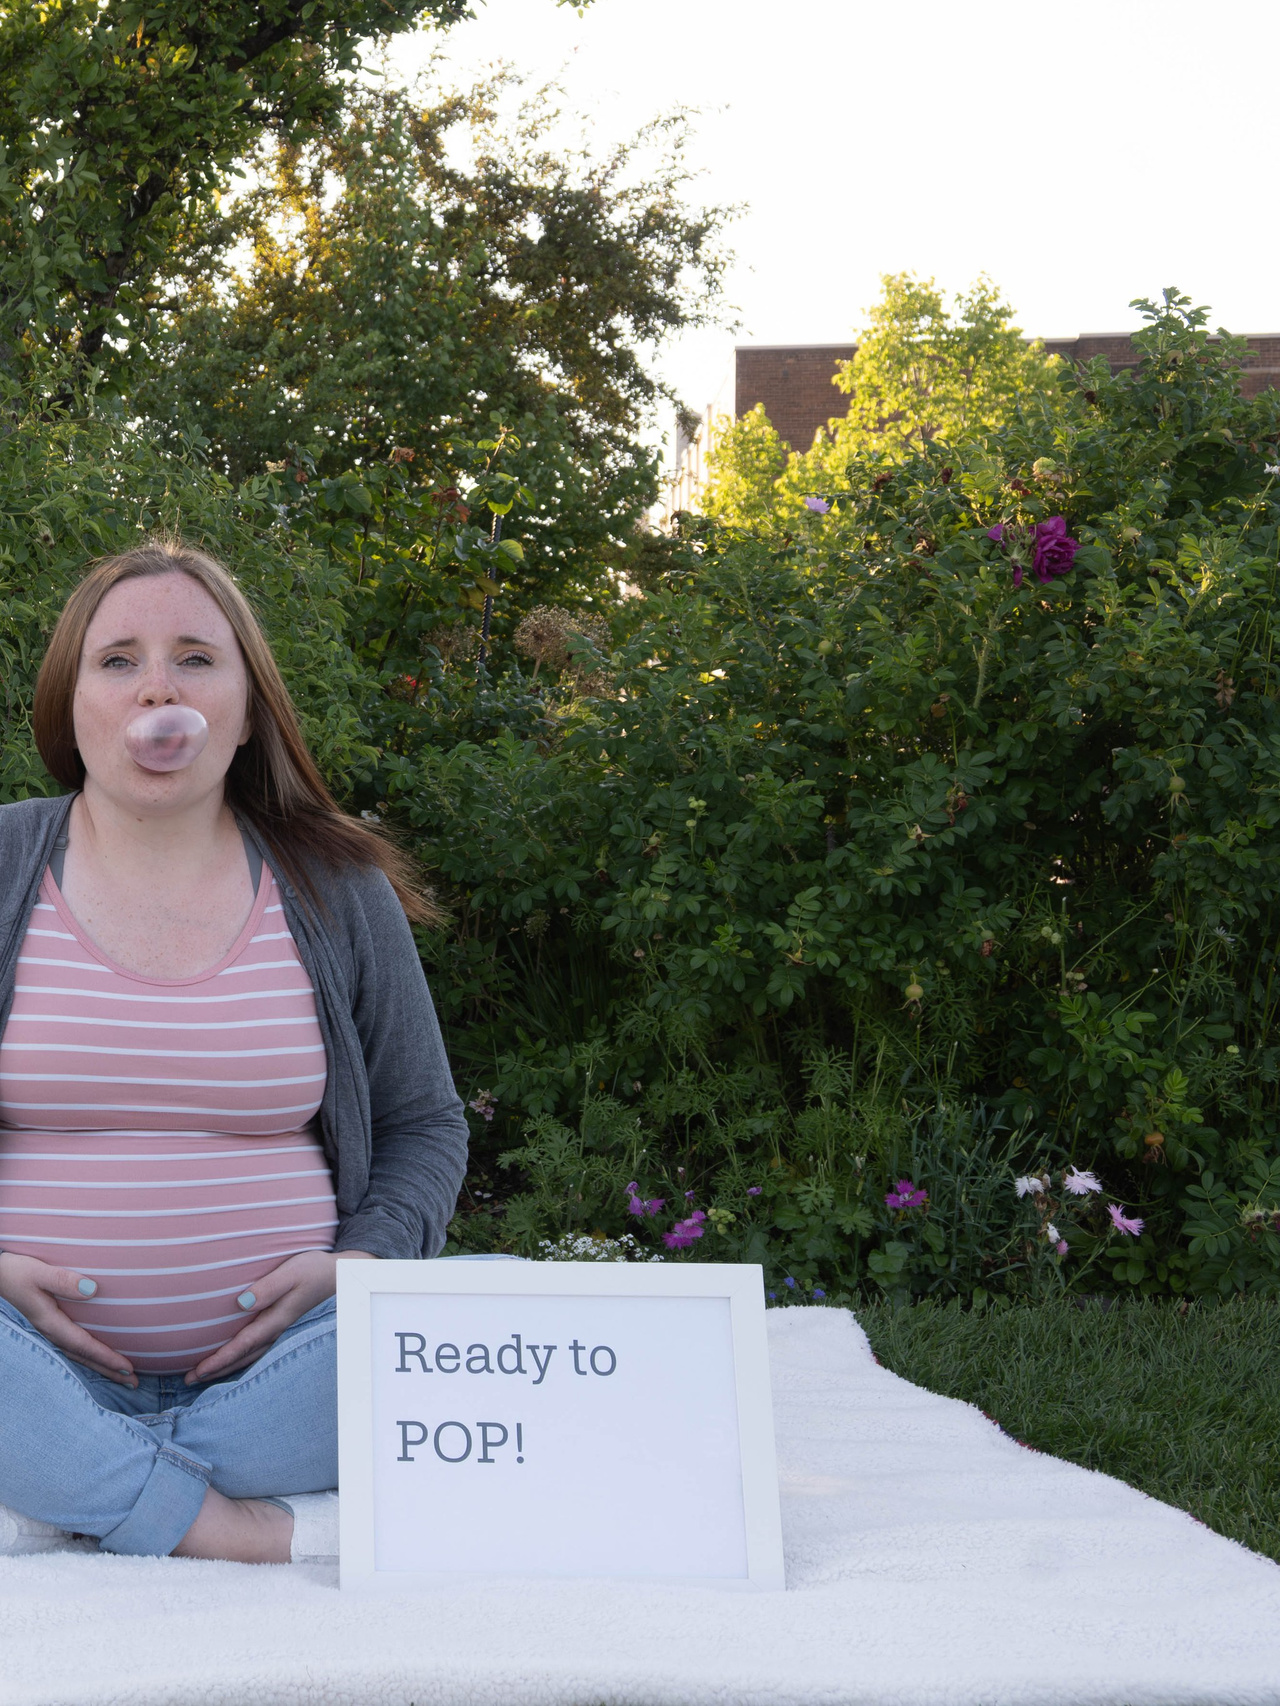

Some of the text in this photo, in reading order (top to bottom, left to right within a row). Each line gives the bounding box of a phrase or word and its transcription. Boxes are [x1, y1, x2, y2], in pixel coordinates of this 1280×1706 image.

[394, 1332, 617, 1385] Ready to
[395, 1420, 526, 1464] POP!
